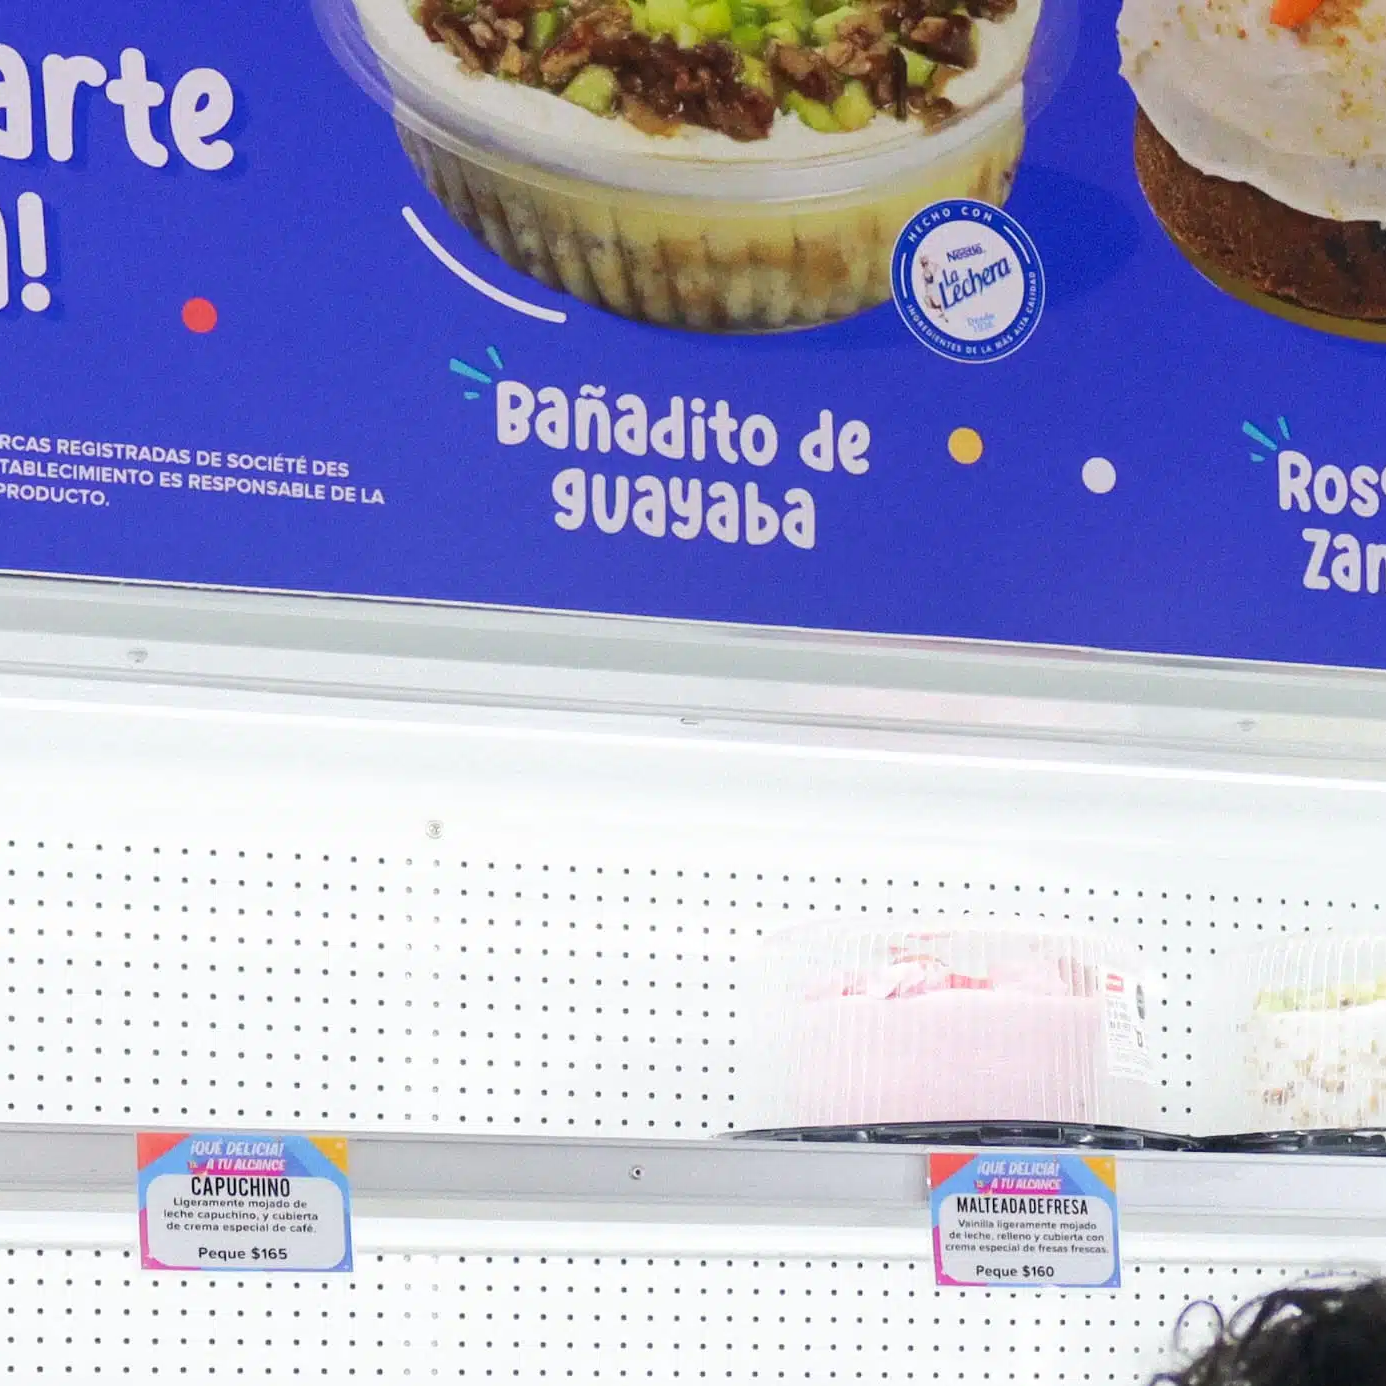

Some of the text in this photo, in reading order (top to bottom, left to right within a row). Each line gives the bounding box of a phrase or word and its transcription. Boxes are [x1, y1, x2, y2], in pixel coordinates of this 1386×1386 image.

[961, 206, 994, 223] CON
[938, 257, 1012, 310] Lechera
[496, 380, 871, 475] Bañadito de
[56, 439, 191, 465] REGISTRADAS
[196, 450, 221, 468] DE
[226, 451, 307, 475] SOCIÉTÉ
[312, 459, 350, 479] DES
[159, 470, 183, 489] ES
[188, 472, 326, 500] RESPONSABLE
[330, 485, 356, 503] DE
[361, 487, 385, 505] LA
[552, 467, 816, 550] guayaba
[205, 1158, 287, 1172] A TU ALCANCE
[191, 1176, 291, 1197] CAPUCHINO
[173, 1197, 308, 1210] Ligeramente mojado de
[1046, 1199, 1089, 1215] FRESA
[164, 1209, 194, 1219] leche
[197, 1210, 260, 1222] capuchino,
[272, 1211, 319, 1222] cubierta
[166, 1222, 181, 1232] de
[184, 1223, 219, 1232] crema
[222, 1223, 269, 1234] especial
[272, 1223, 287, 1233] de
[958, 1219, 1097, 1232] Vainilla ligeramente mojado
[949, 1231, 962, 1240] de
[996, 1232, 1031, 1242] relleno
[1042, 1233, 1083, 1242] cubierta
[1085, 1234, 1104, 1242] con
[198, 1247, 289, 1262] Peque $165
[945, 1243, 976, 1252] crema
[979, 1243, 1020, 1253] especial
[1023, 1244, 1035, 1252] de
[1037, 1244, 1068, 1253] fresas
[976, 1265, 1054, 1280] Peque $160
